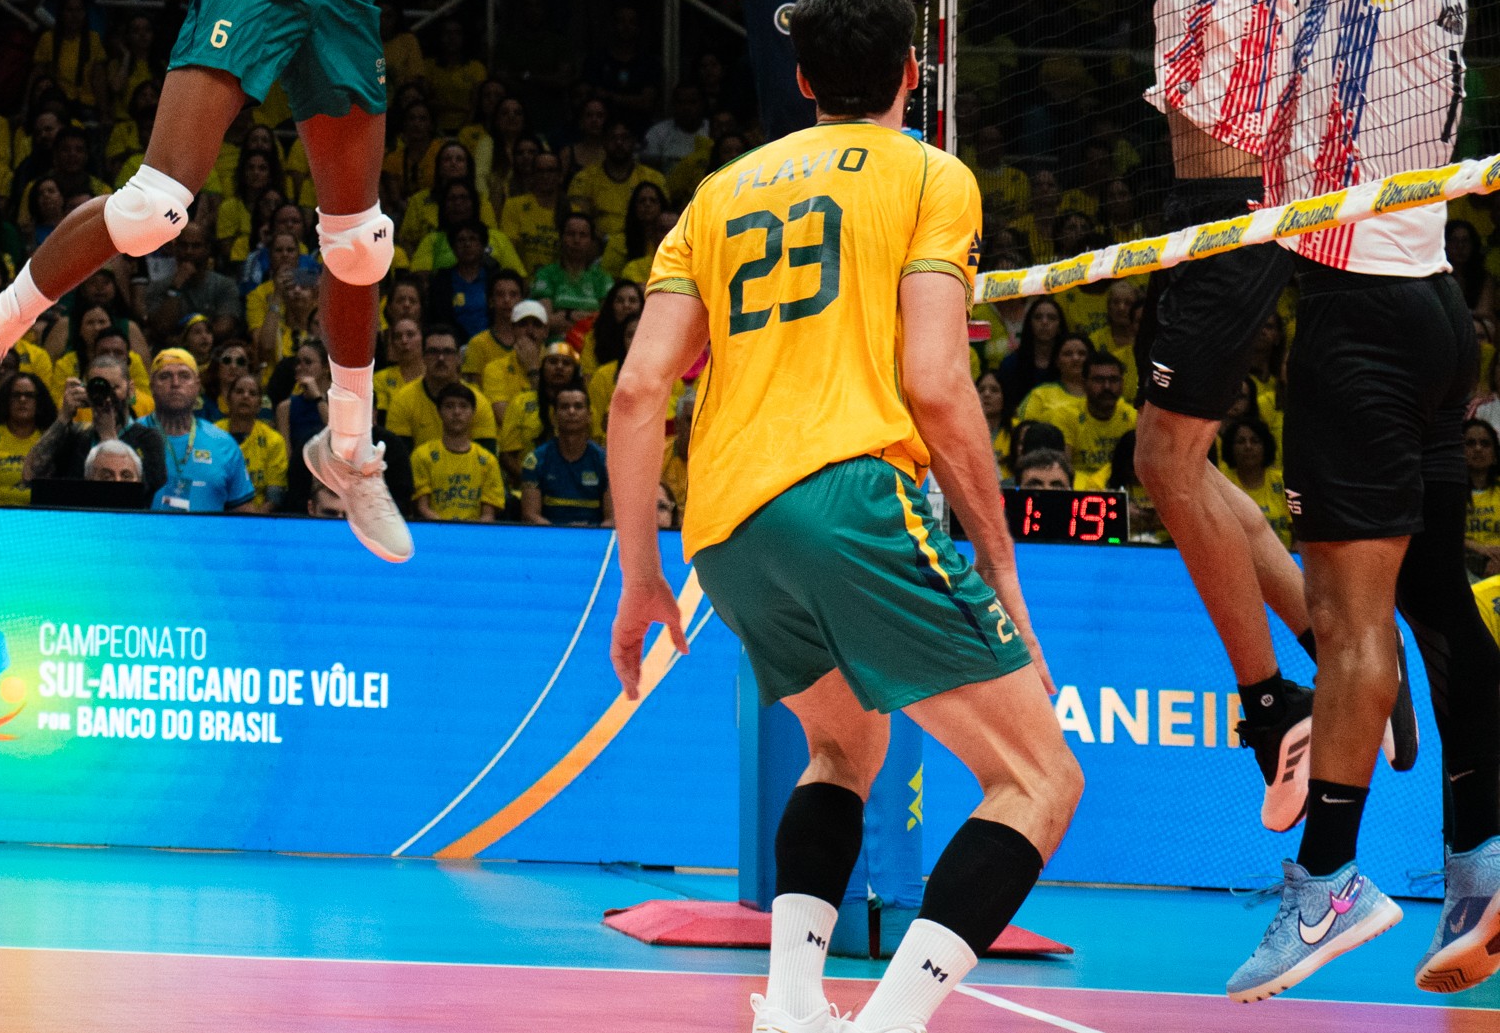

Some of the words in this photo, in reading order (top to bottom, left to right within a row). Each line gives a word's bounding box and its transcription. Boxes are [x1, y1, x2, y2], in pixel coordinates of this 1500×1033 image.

[211, 19, 232, 48] 6
[733, 147, 869, 198] FLAVIO
[726, 195, 843, 337] 23
[39, 623, 207, 660] CAMPEONATO
[988, 602, 1020, 644] 2
[39, 661, 260, 705] SUL-AMERICANO
[268, 669, 304, 706] DE
[311, 662, 390, 709] VÔLEI
[77, 706, 156, 740] BANCO
[161, 709, 193, 741] DO
[199, 710, 283, 744] BRASIL
